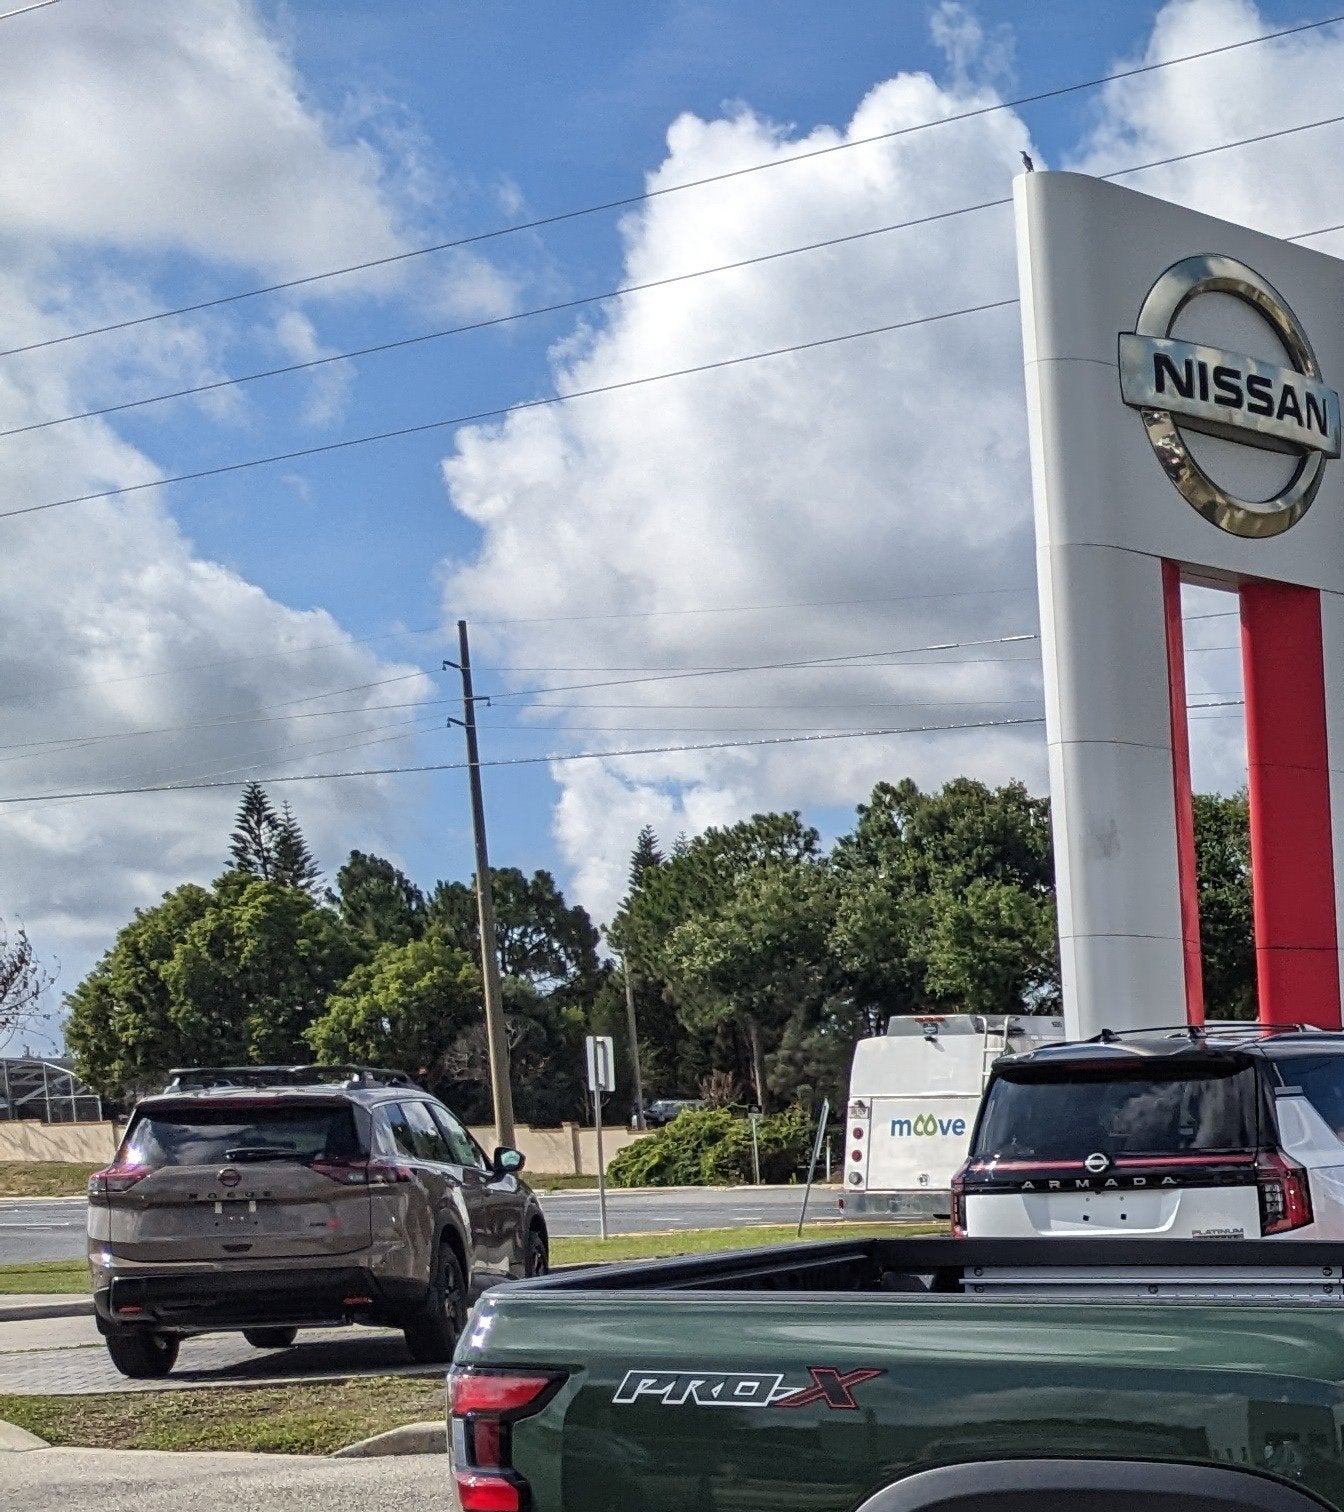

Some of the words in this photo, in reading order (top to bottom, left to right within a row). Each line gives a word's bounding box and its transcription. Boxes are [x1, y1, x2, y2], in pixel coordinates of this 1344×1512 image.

[1153, 352, 1329, 438] NISSAN
[890, 1113, 966, 1137] moove
[1021, 1176, 1178, 1190] ARMADA
